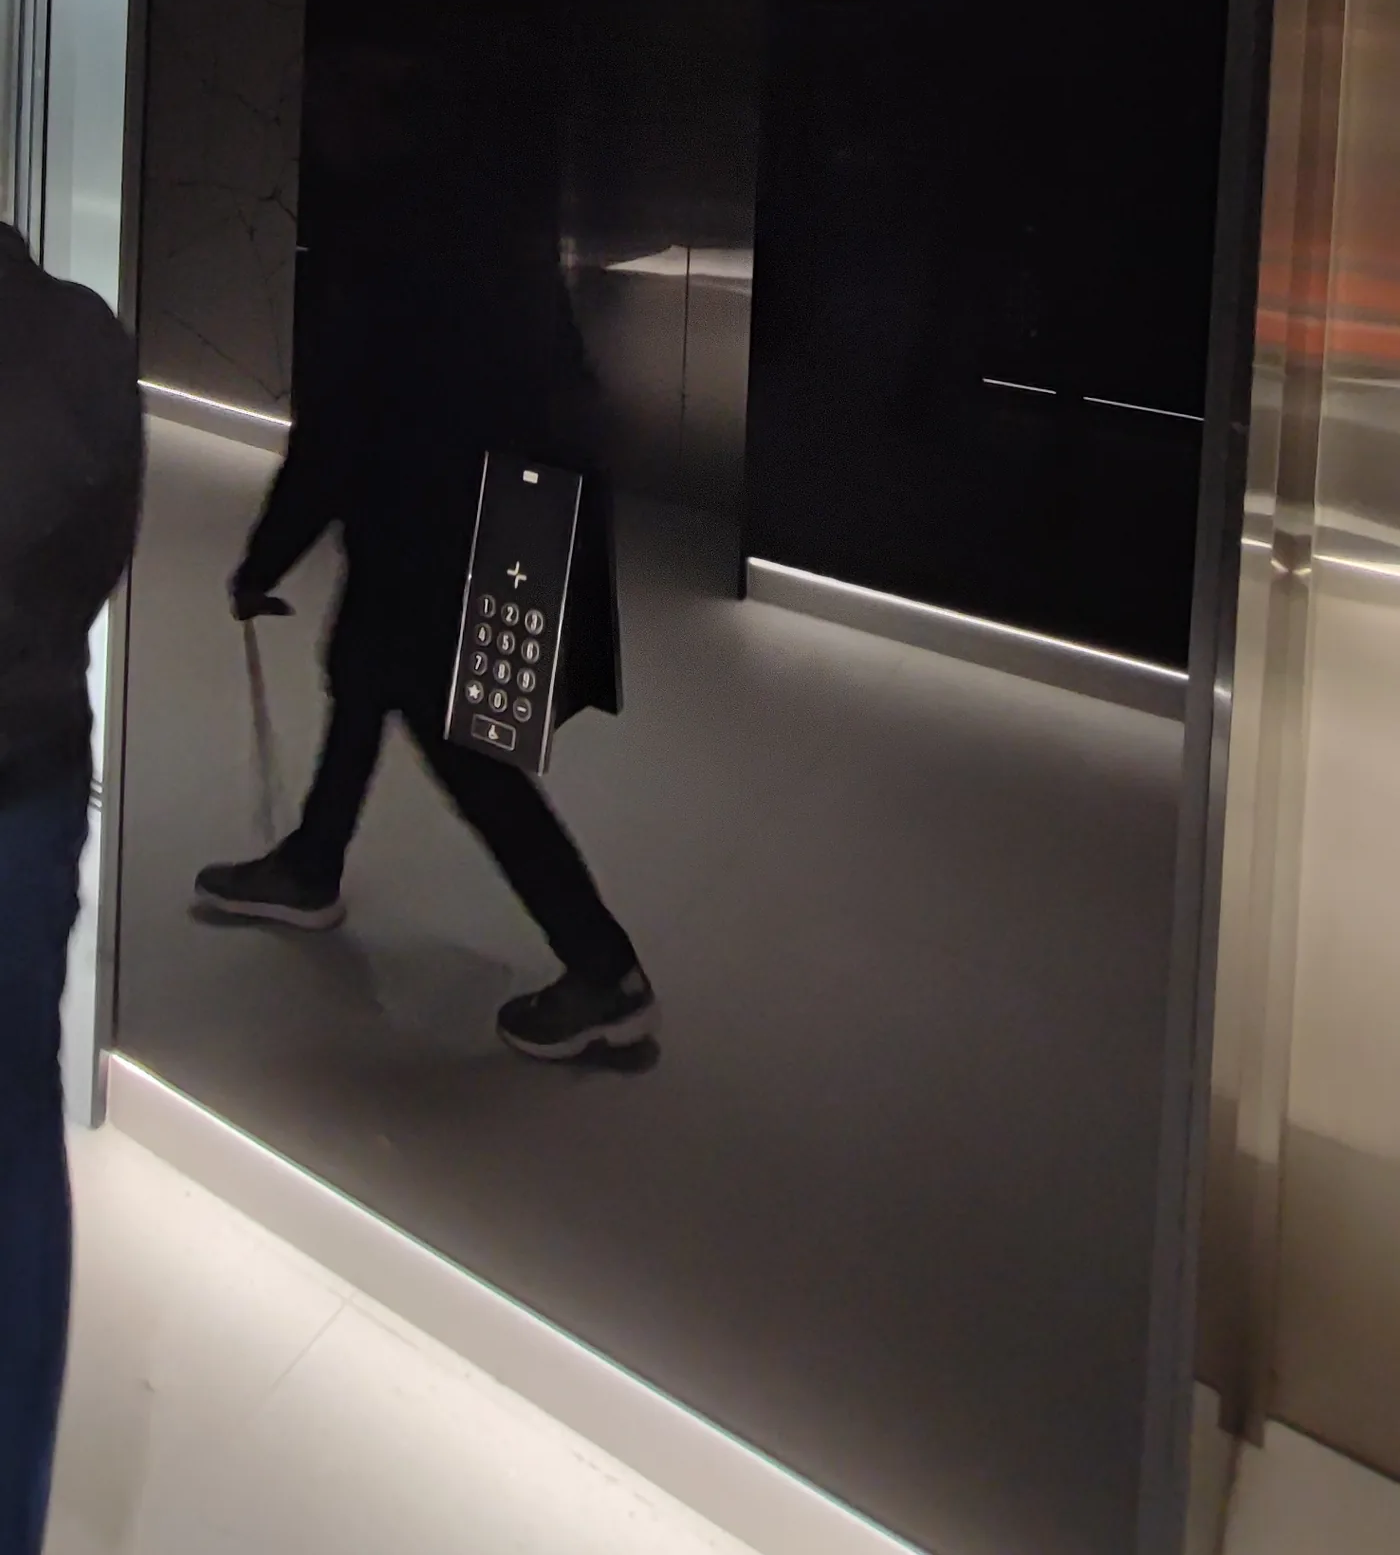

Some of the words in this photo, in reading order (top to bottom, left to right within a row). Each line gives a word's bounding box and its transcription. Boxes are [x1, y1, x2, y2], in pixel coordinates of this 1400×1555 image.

[505, 606, 514, 622] 2
[478, 626, 486, 642] 4
[502, 634, 509, 651] 5
[475, 654, 482, 670] 7
[522, 671, 530, 689] 9
[493, 692, 502, 708] 0
